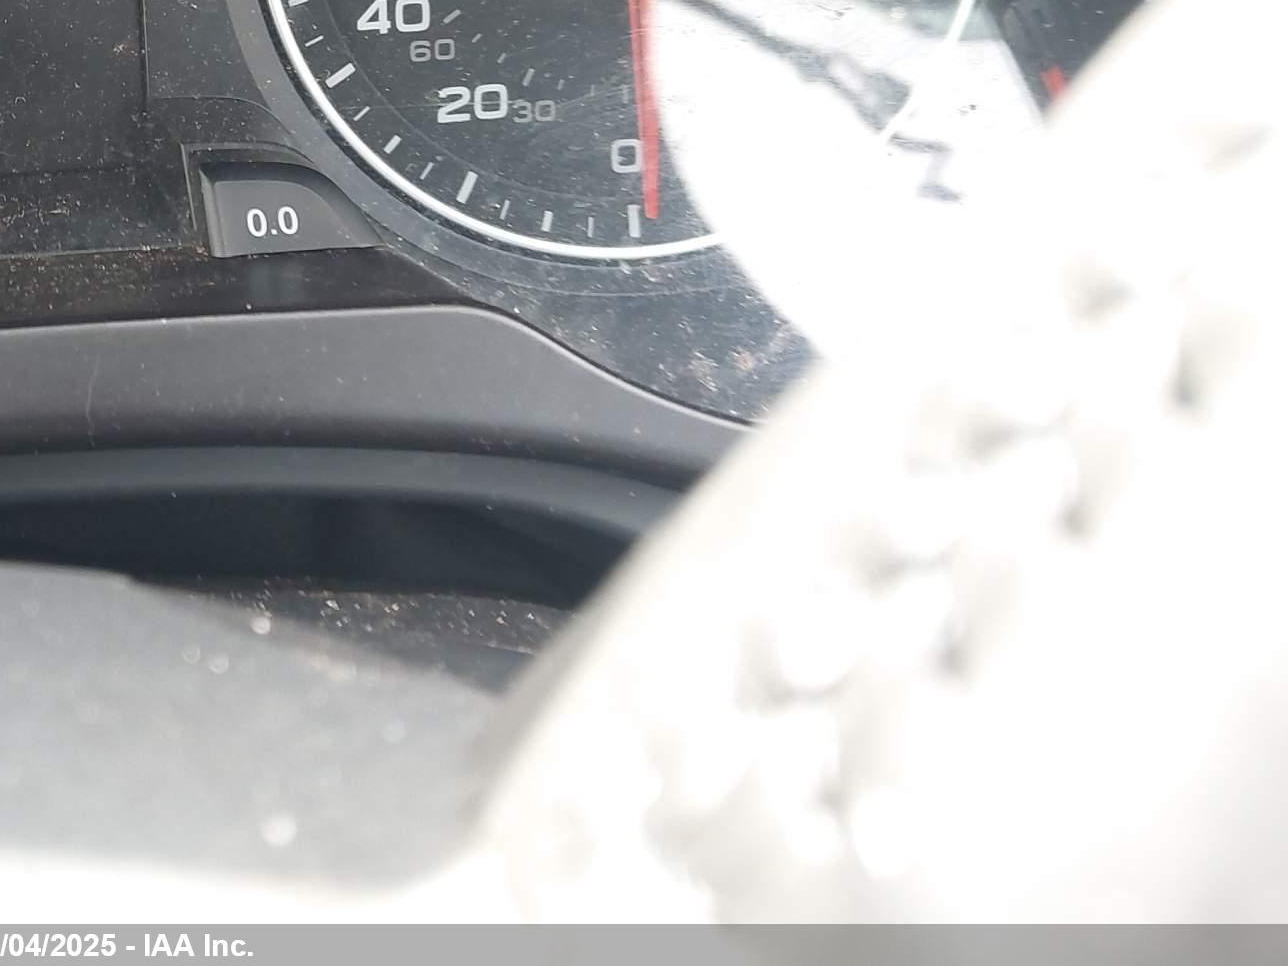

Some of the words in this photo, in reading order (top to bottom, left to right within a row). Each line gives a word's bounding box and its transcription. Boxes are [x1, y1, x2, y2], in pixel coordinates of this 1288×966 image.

[409, 38, 455, 62] 60
[436, 84, 509, 123] 20
[513, 99, 556, 123] 30
[610, 140, 642, 174] 0
[246, 207, 299, 237] 0.0
